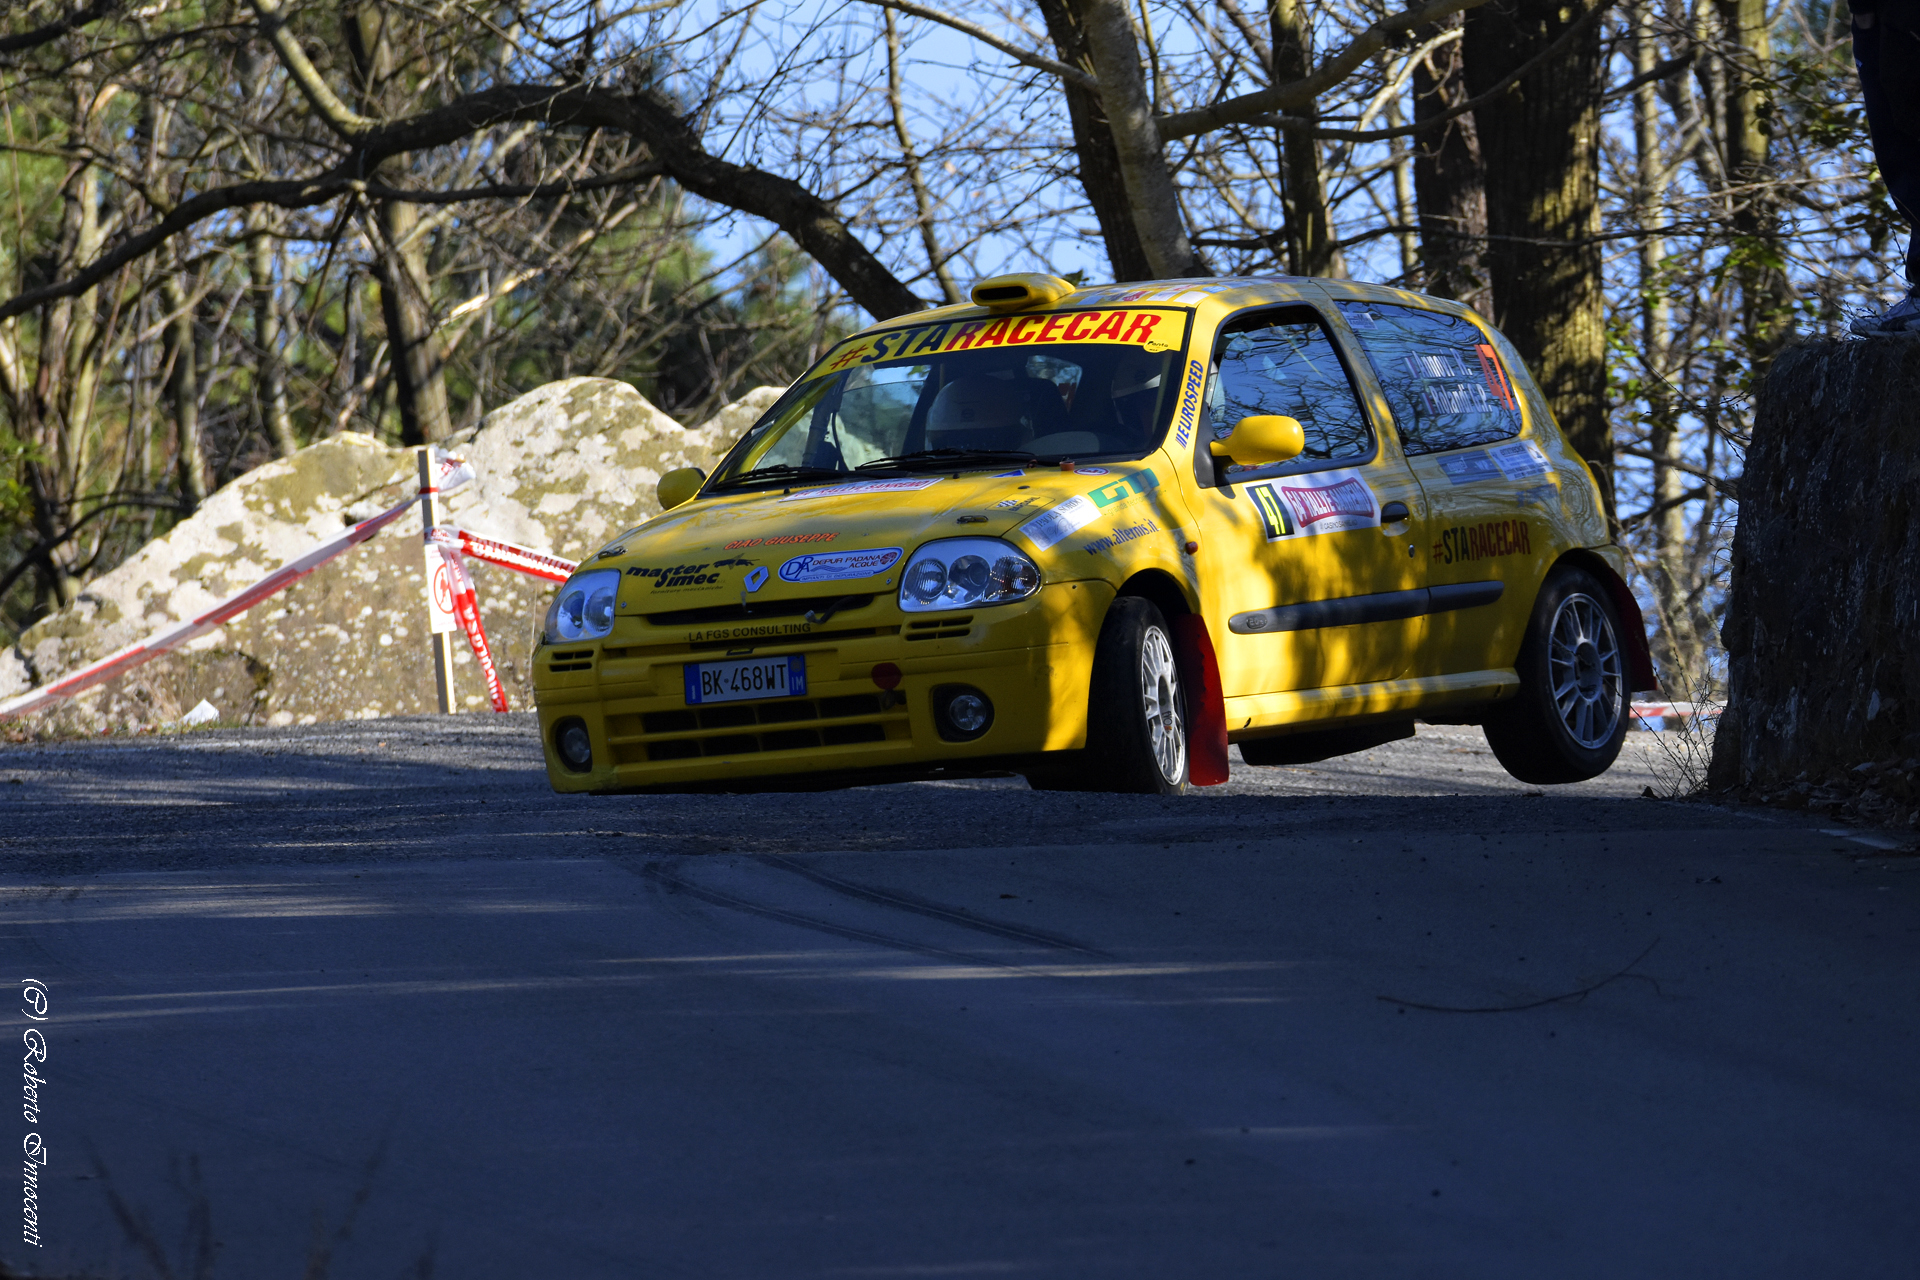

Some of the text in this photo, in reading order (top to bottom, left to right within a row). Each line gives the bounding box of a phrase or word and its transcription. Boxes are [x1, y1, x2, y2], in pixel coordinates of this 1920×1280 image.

[829, 311, 1162, 370] #STARACECAR
[1474, 344, 1515, 411] 47
[1177, 359, 1204, 440] EUROSPEED
[1036, 505, 1063, 528] PAOLA
[1056, 497, 1084, 515] SORDO
[1254, 486, 1286, 535] 47
[1303, 489, 1335, 518] RALLYE
[724, 532, 840, 550] CIAO GIUSEPPE
[1083, 517, 1160, 556] www.alternis.it
[1432, 519, 1532, 565] #STARACECAR
[812, 554, 881, 566] DEPUR PADANA
[848, 560, 879, 569] ACQUE
[689, 623, 811, 642] LA FGS CONSULTING
